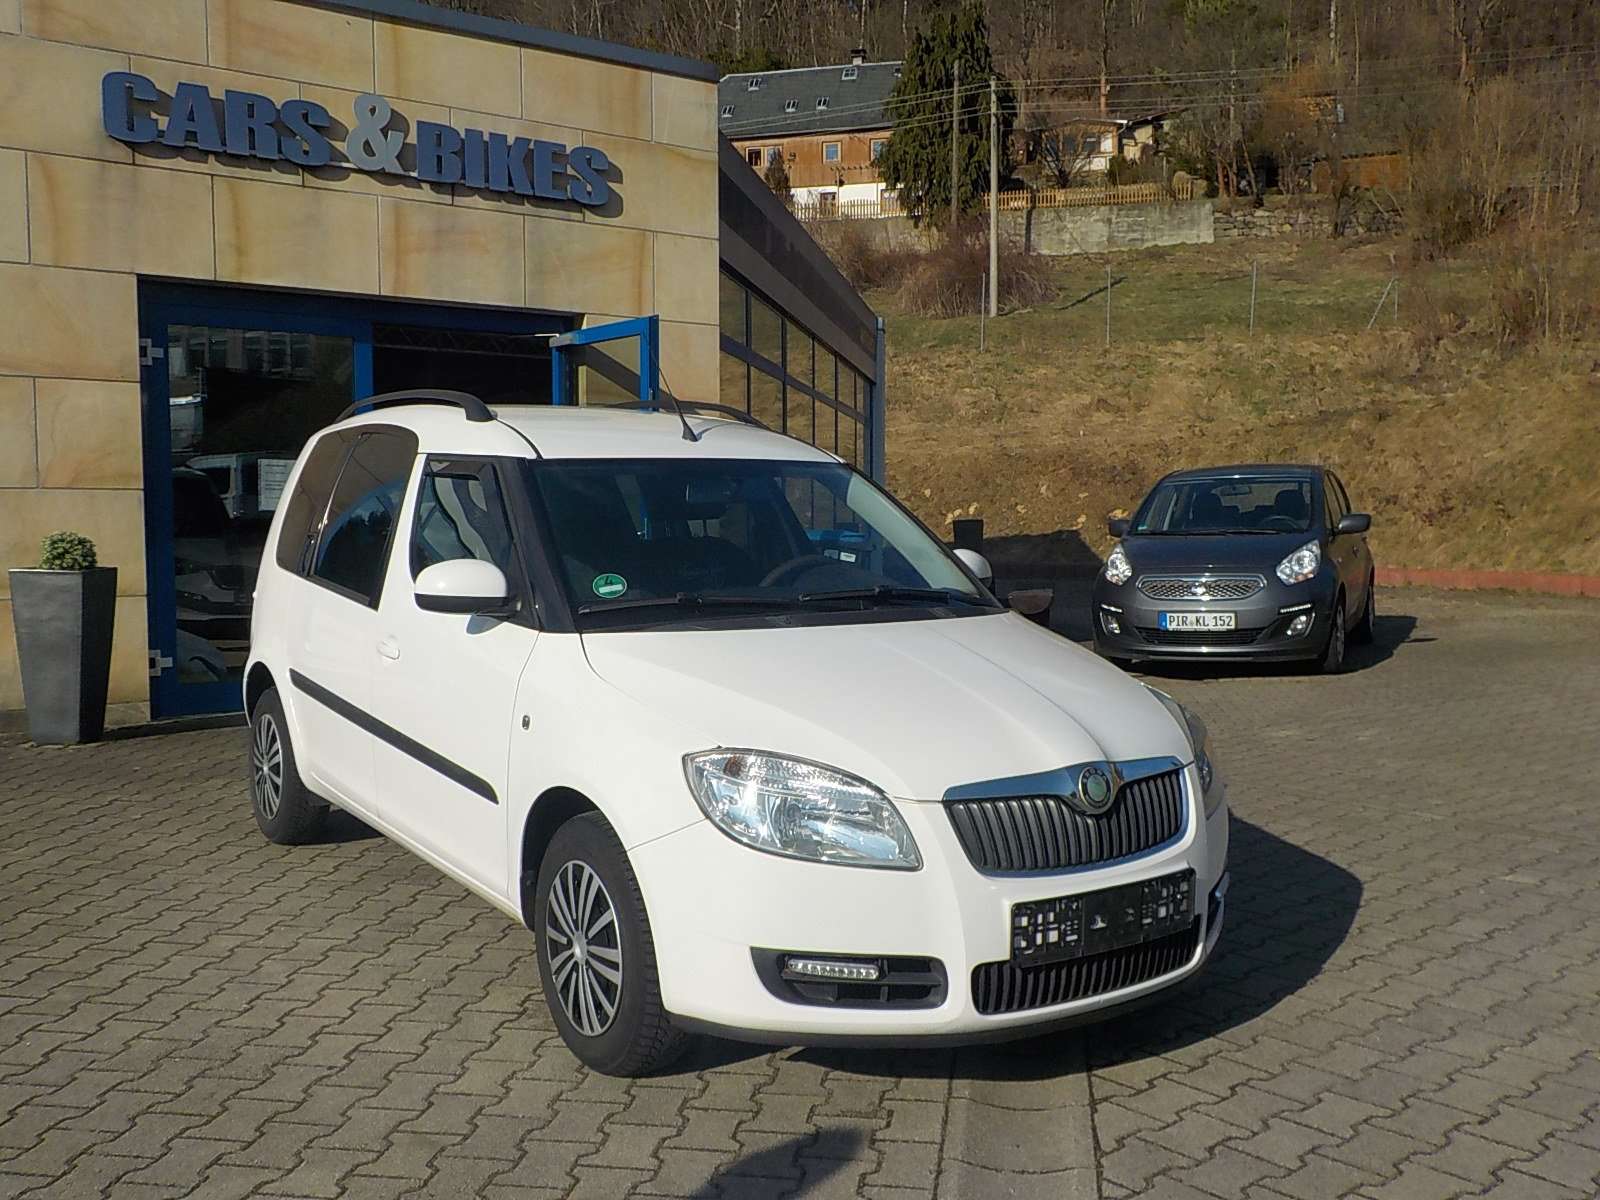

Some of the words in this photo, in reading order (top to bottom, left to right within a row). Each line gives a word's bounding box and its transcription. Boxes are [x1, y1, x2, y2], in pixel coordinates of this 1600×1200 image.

[102, 72, 331, 166] CARS
[345, 94, 404, 173] &
[416, 120, 610, 205] BIKES
[1168, 615, 1188, 627] PIR
[1195, 615, 1209, 627] KL
[1212, 615, 1233, 627] 152
